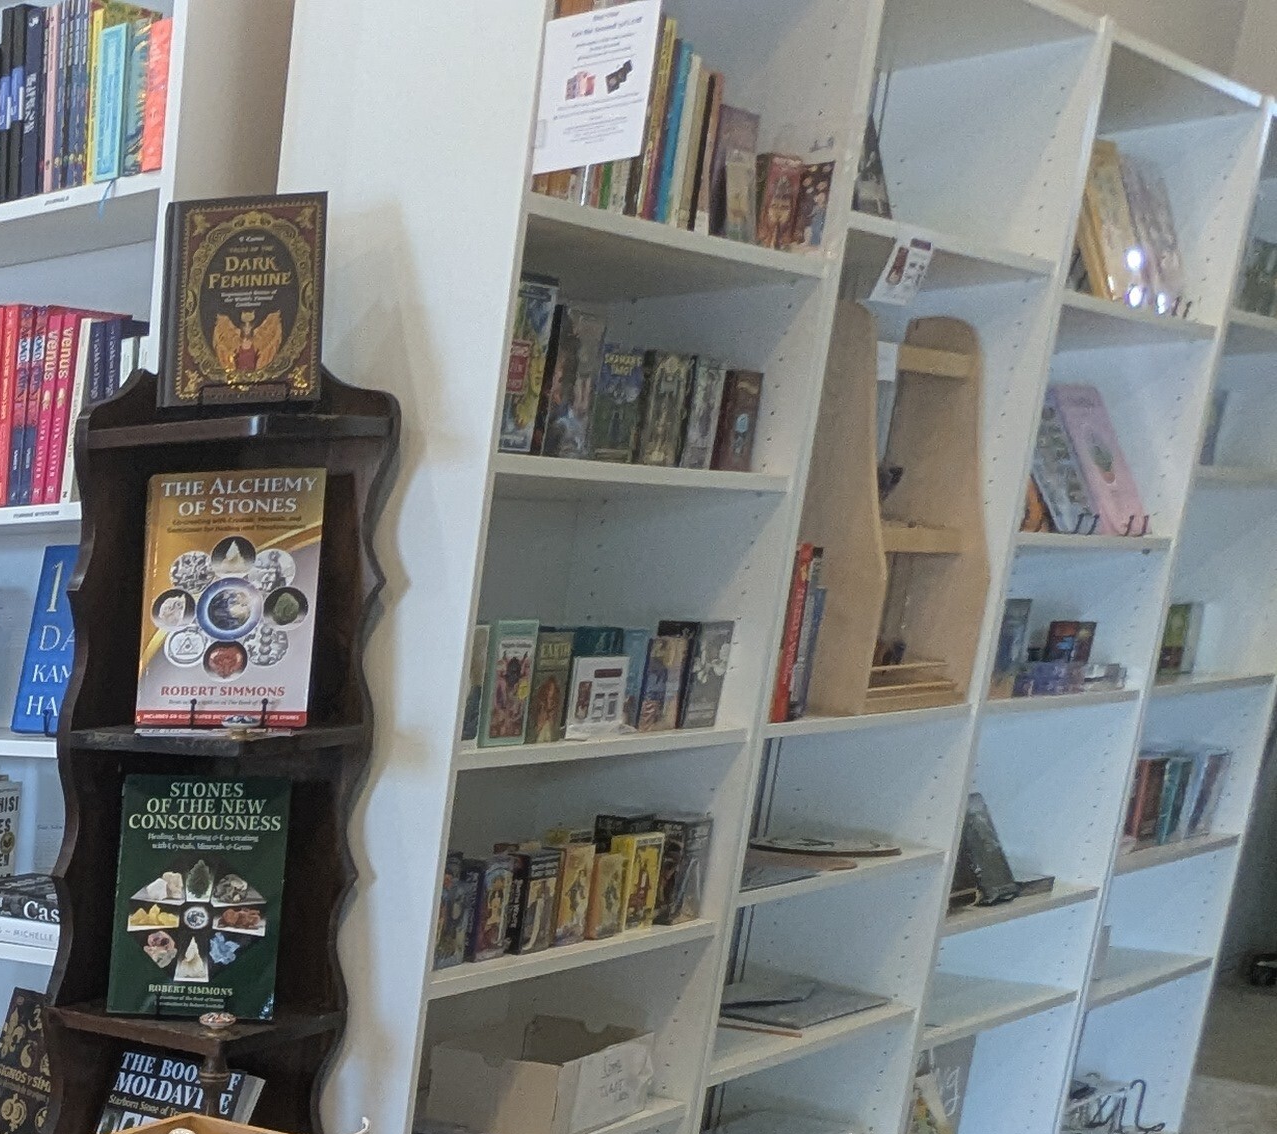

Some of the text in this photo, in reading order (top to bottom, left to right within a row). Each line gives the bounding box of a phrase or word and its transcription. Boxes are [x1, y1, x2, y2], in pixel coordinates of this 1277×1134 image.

[225, 257, 278, 272] DARK
[209, 271, 291, 289] FEMININE
[42, 329, 57, 381] venus
[59, 327, 73, 378] venus
[161, 477, 317, 497] THE ALCHEMY
[178, 497, 296, 516] OF STONES
[161, 686, 285, 697] ROBERT SIMMONS
[170, 782, 244, 798] STONES
[146, 799, 266, 814] OF THE NEW
[128, 815, 281, 831] CONSCIOUSNESS
[13, 928, 54, 941] MICHELLE
[148, 983, 233, 996] ROBERT SIMMONS
[122, 1052, 200, 1083] THE BOO
